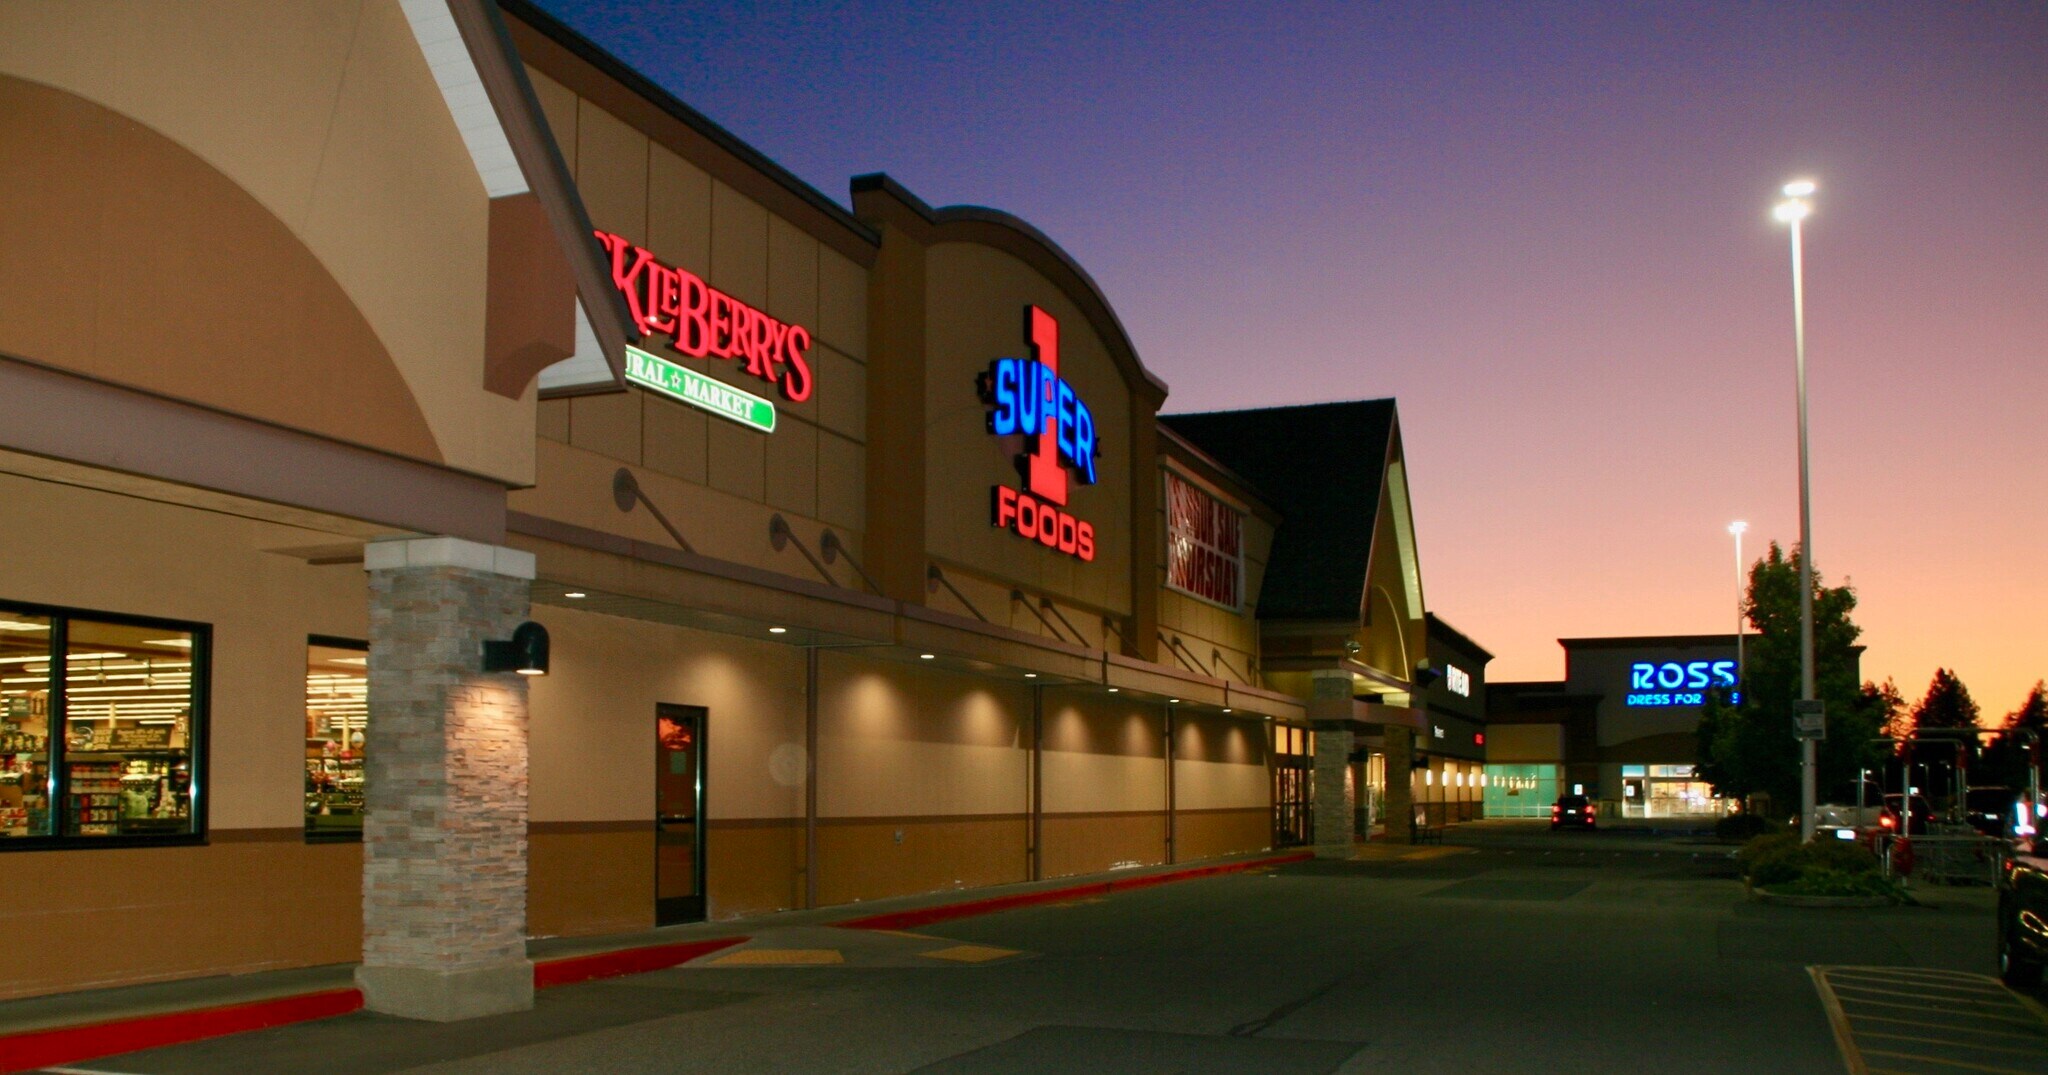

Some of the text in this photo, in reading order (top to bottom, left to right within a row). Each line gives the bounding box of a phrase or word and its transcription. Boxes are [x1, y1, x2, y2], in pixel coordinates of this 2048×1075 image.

[683, 375, 754, 419] MARKET
[993, 358, 1096, 485] SUPER
[998, 485, 1094, 561] FOODS
[1633, 662, 1735, 689] ROSS
[1627, 693, 1702, 705] DRESS FOR
